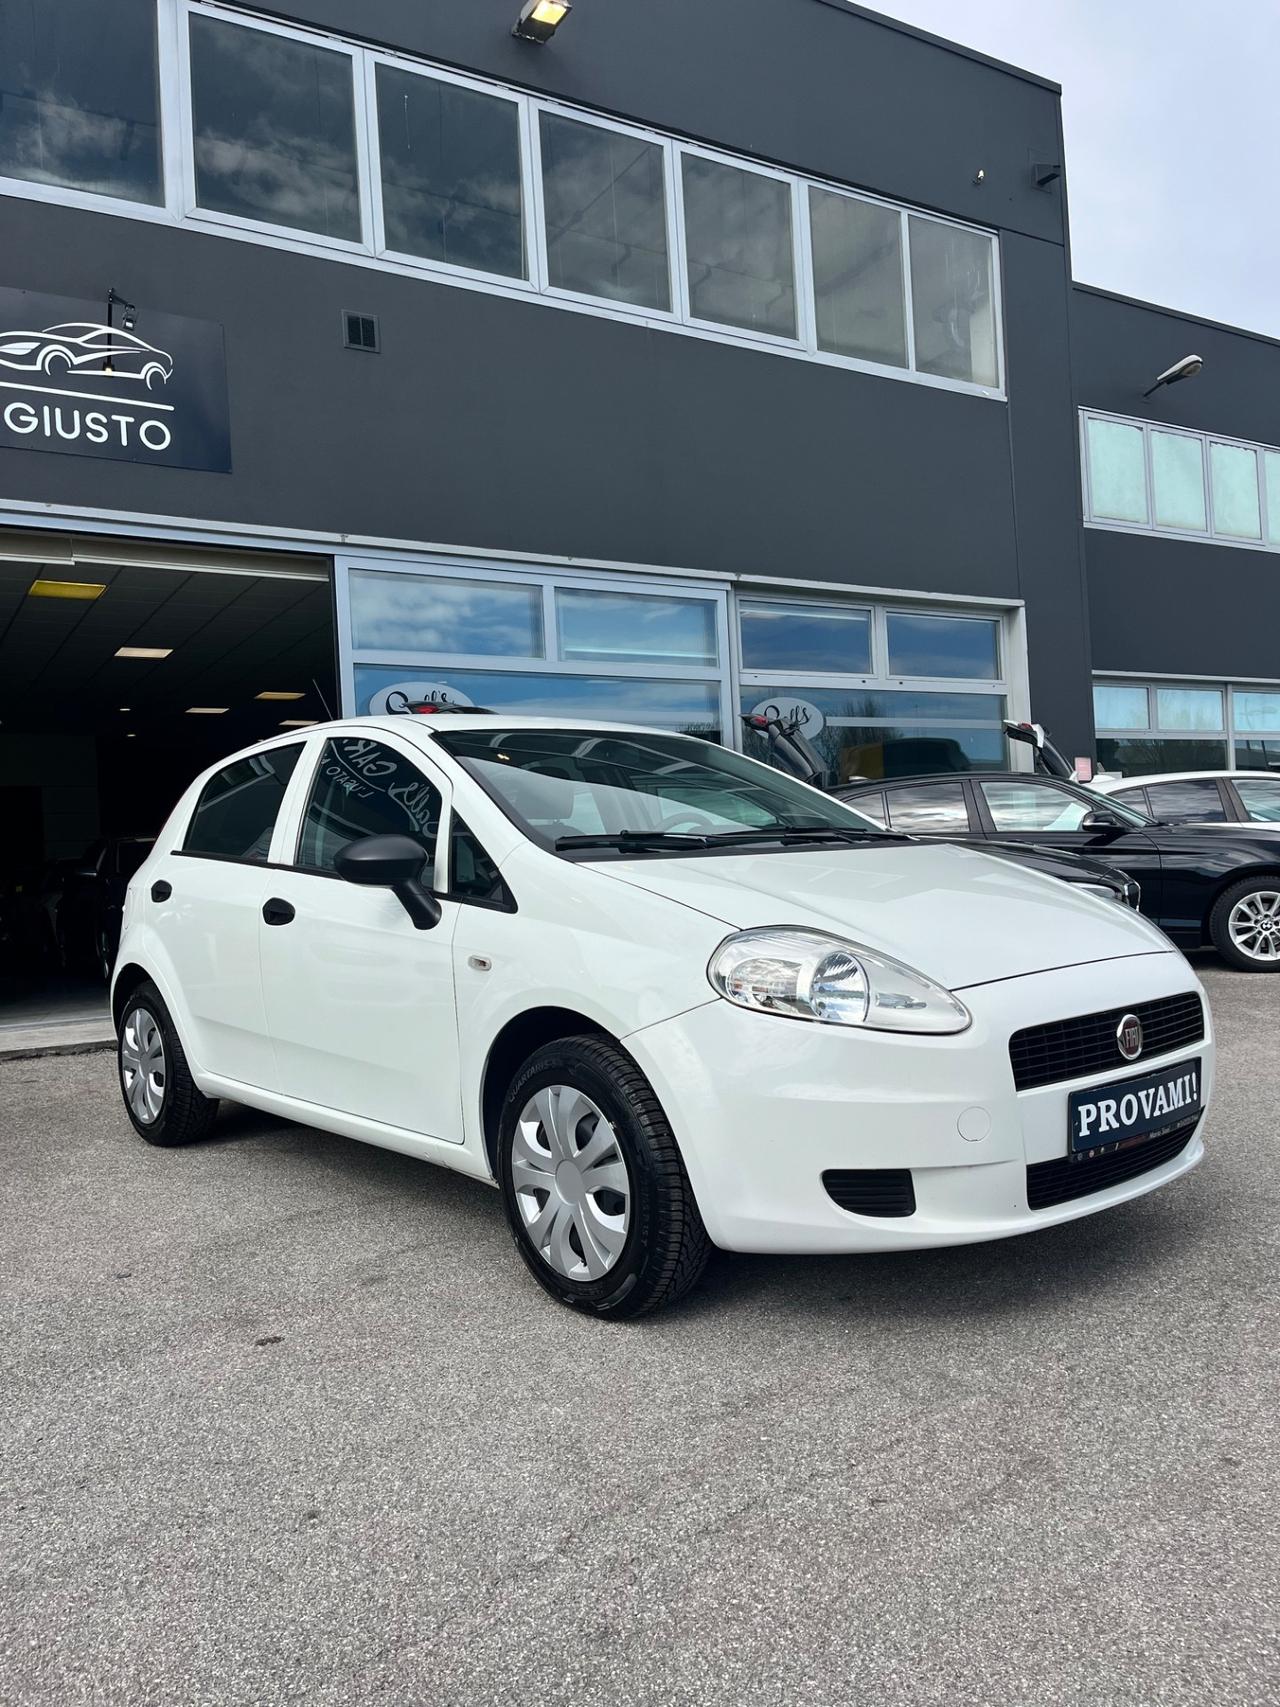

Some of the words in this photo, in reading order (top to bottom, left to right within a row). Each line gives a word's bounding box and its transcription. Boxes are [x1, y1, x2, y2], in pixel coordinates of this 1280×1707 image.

[4, 402, 171, 451] GIUSTO
[1124, 1026, 1139, 1049] FIAT
[1077, 1071, 1198, 1138] PROVAMI!
